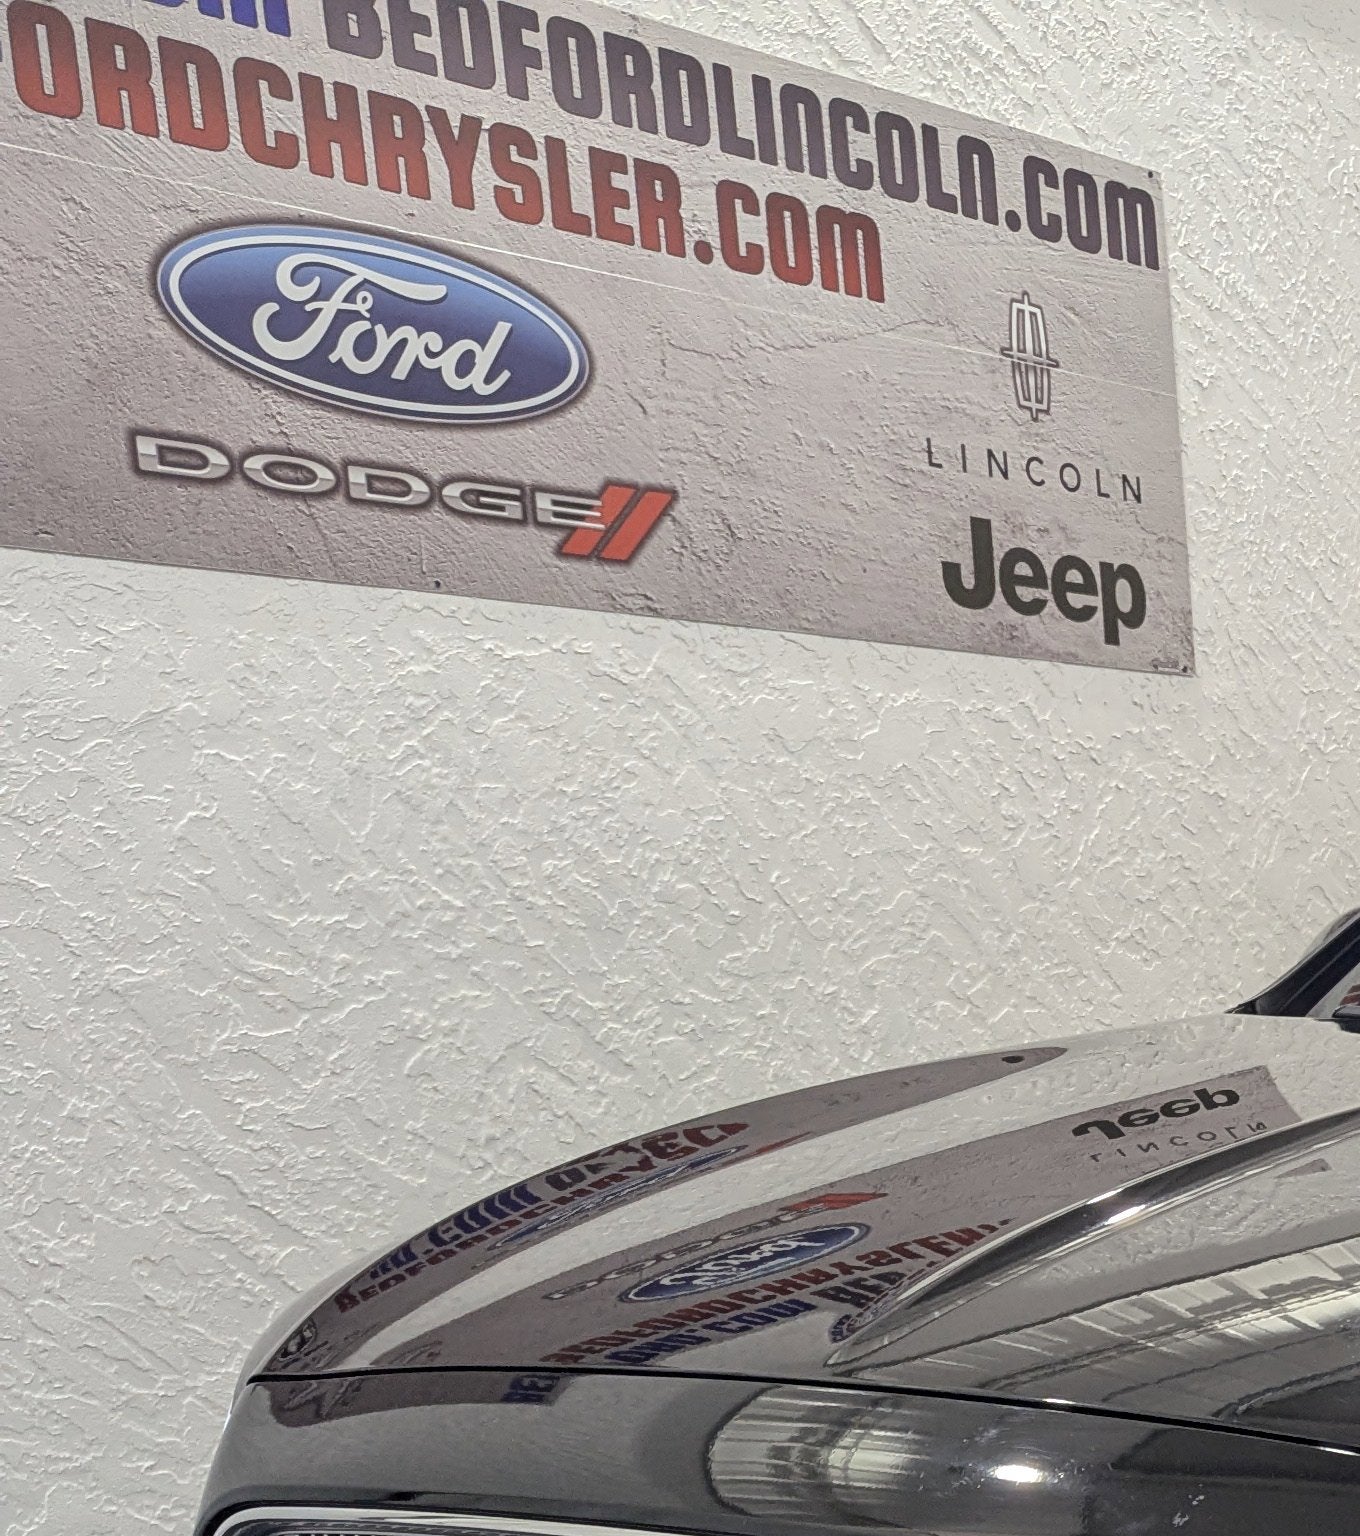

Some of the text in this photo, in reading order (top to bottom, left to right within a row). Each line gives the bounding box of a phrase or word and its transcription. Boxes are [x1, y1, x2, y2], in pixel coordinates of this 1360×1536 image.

[0, 0, 886, 303] ORDCHRYSLER.COM
[251, 251, 513, 397] Ford
[135, 434, 606, 531] DODGE
[926, 437, 1142, 504] LINCOLN
[941, 515, 1147, 646] Jeep
